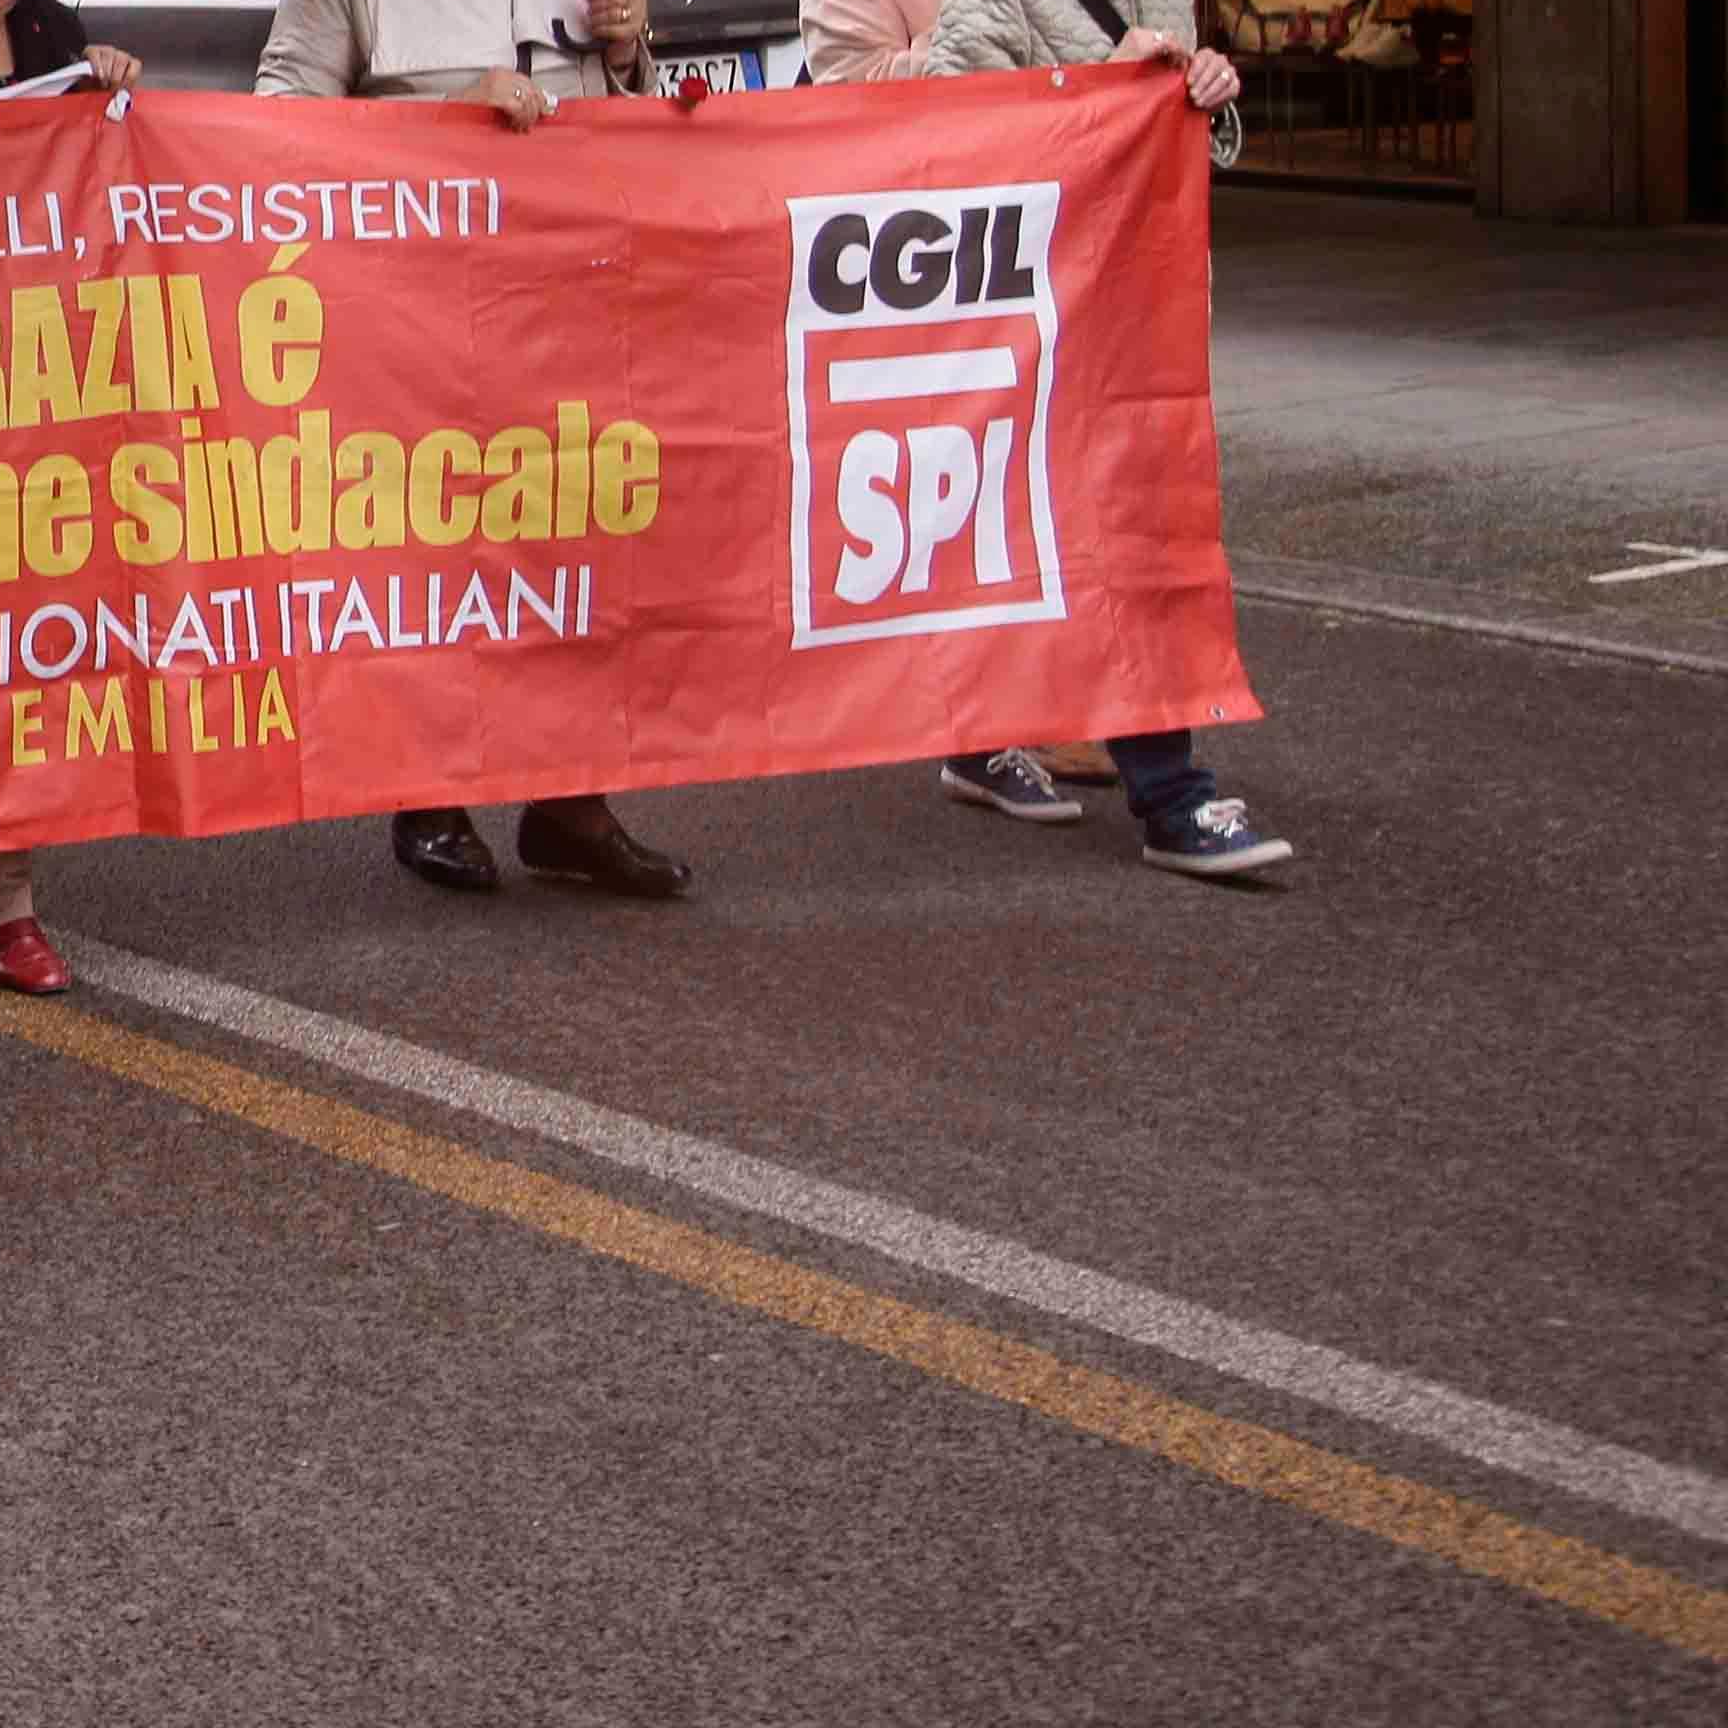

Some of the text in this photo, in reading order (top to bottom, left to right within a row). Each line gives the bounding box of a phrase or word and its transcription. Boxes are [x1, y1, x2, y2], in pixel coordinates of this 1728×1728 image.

[108, 178, 500, 244] RESISTENTI
[808, 205, 1035, 314] CGIL
[237, 242, 323, 407] é
[109, 400, 661, 566] sindacale
[834, 417, 1013, 604] SPI
[279, 565, 592, 656] ITALIANI
[11, 667, 295, 767] EMILIA
